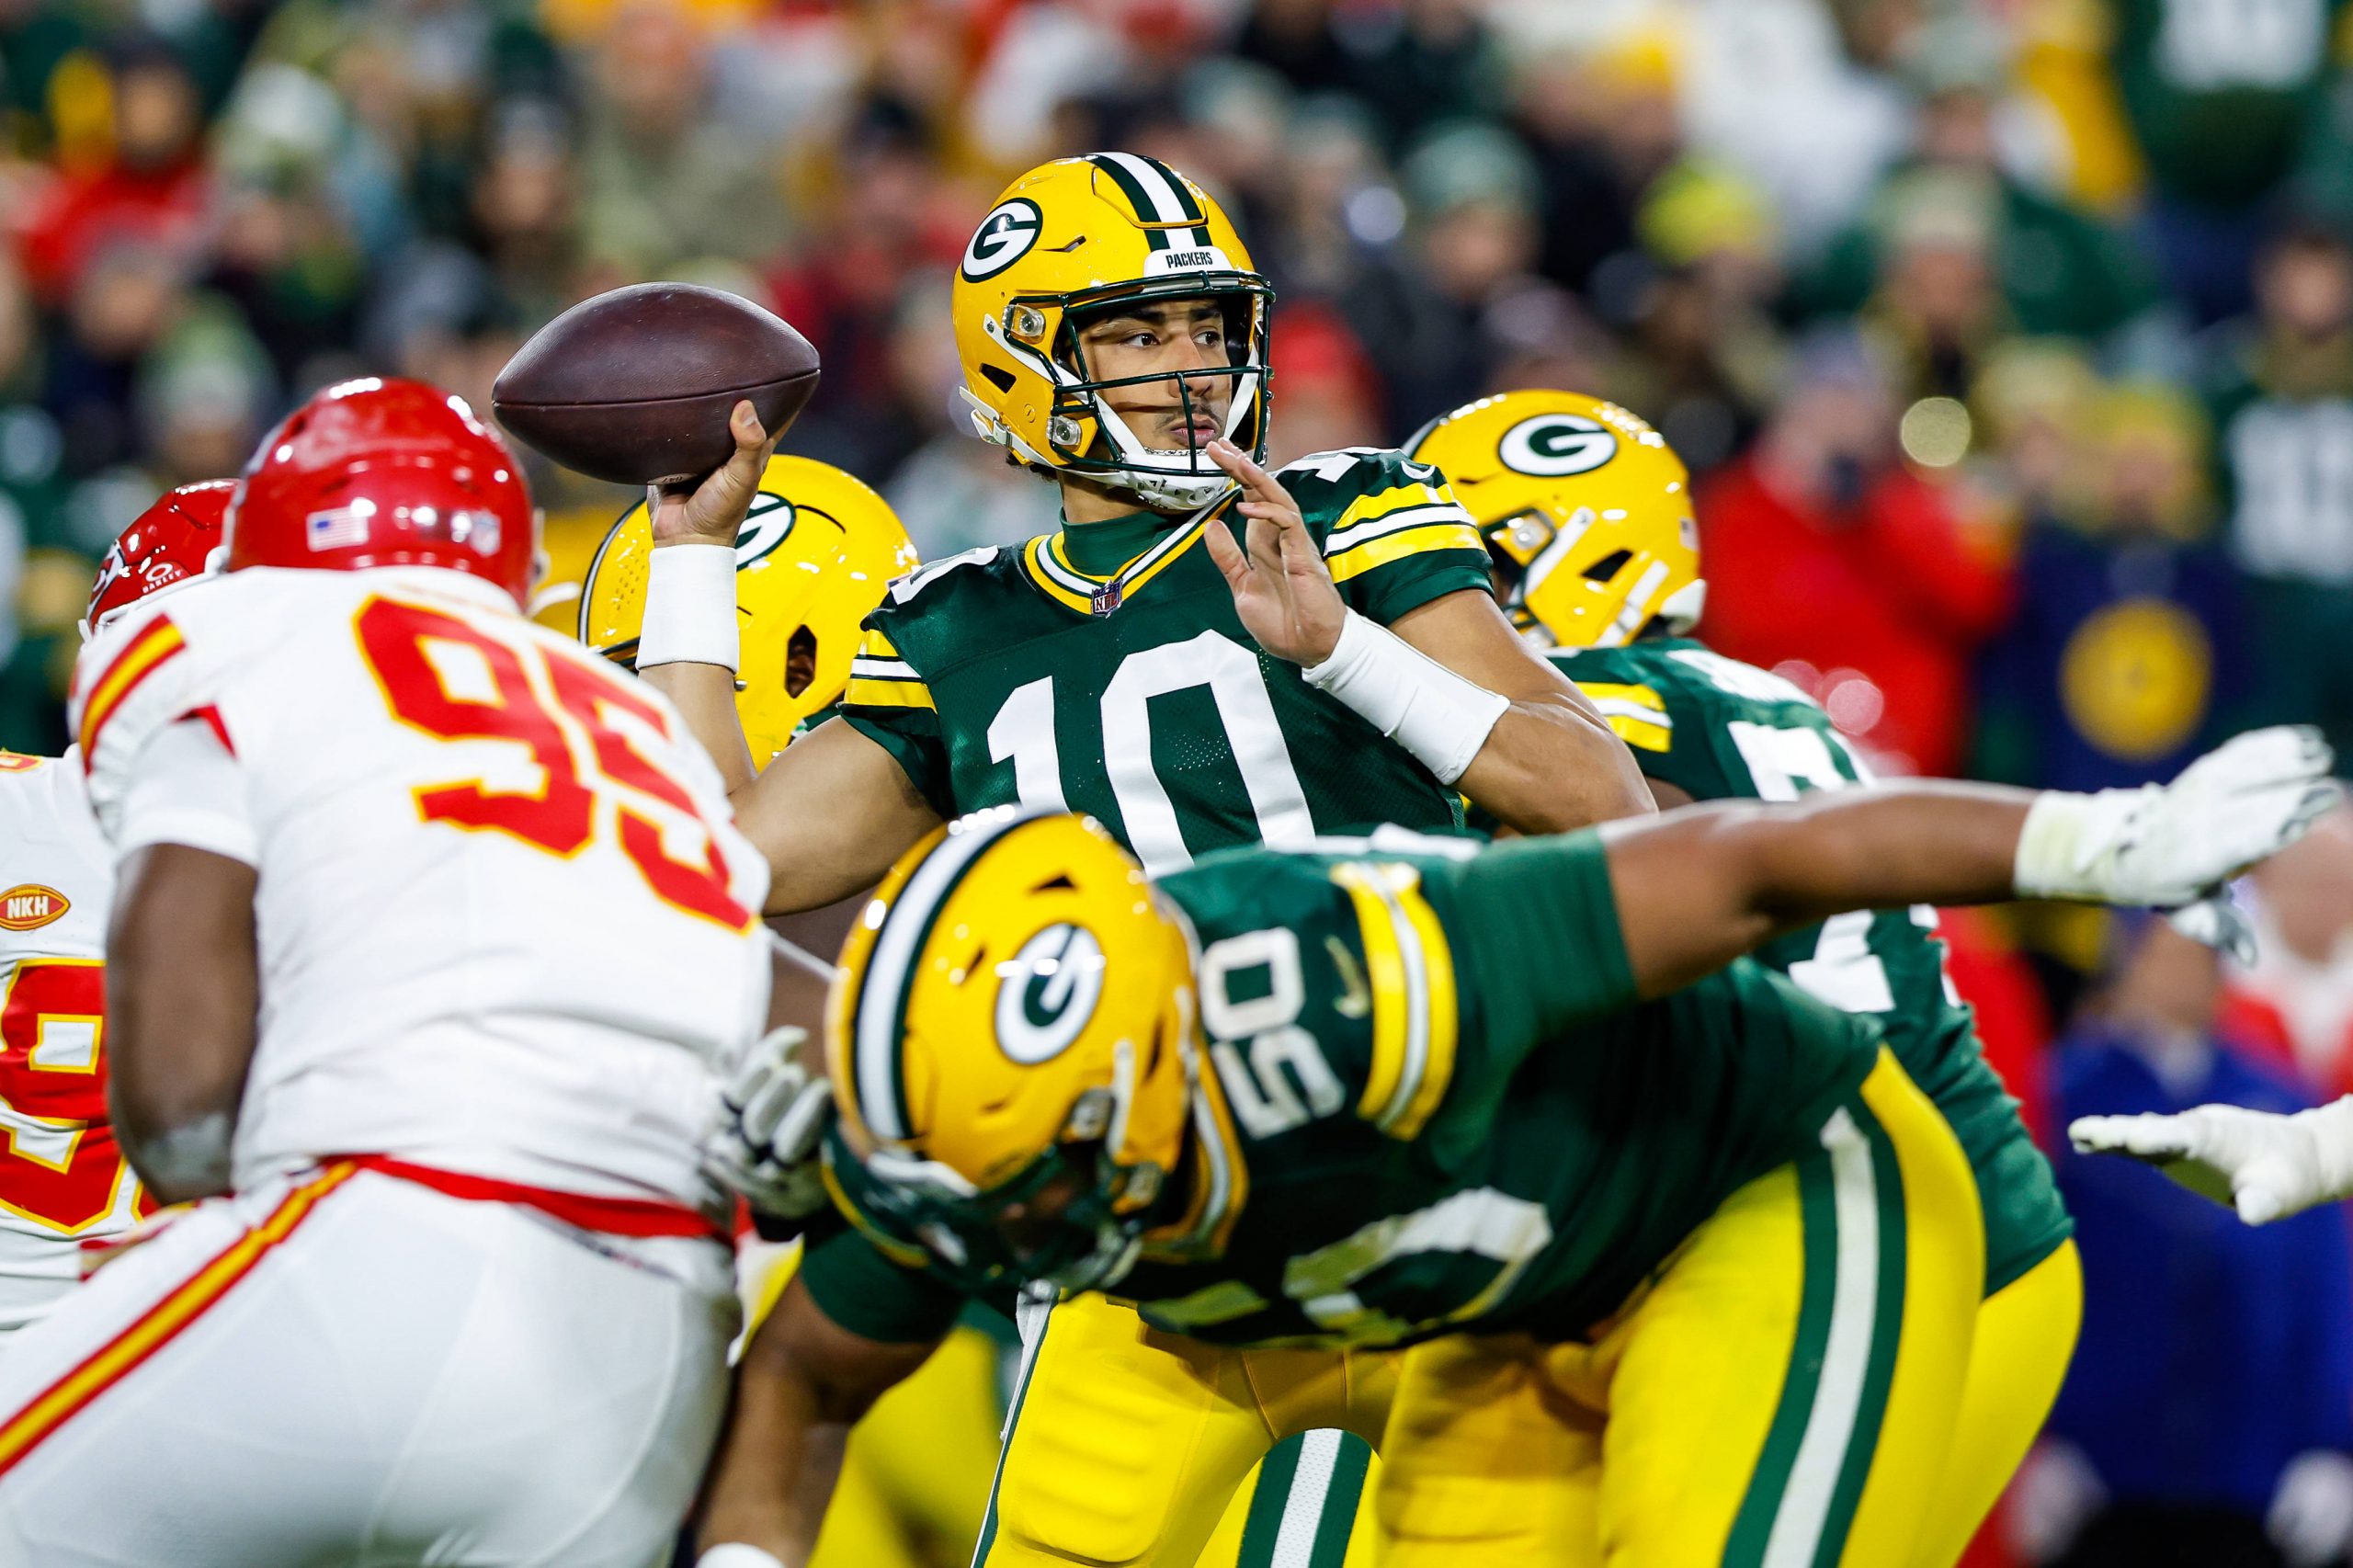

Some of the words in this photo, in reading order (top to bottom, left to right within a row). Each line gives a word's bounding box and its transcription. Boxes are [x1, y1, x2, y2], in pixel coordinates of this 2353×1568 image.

[963, 199, 1040, 277] G
[1165, 252, 1213, 268] PACKERS
[1498, 413, 1618, 476] G
[142, 569, 184, 594] OAKLEY
[1095, 592, 1119, 612] NFL
[350, 591, 762, 938] 95
[986, 629, 1317, 879] 10
[6, 895, 50, 919] NKH
[993, 921, 1106, 1068] G
[1198, 916, 1347, 1142] 50
